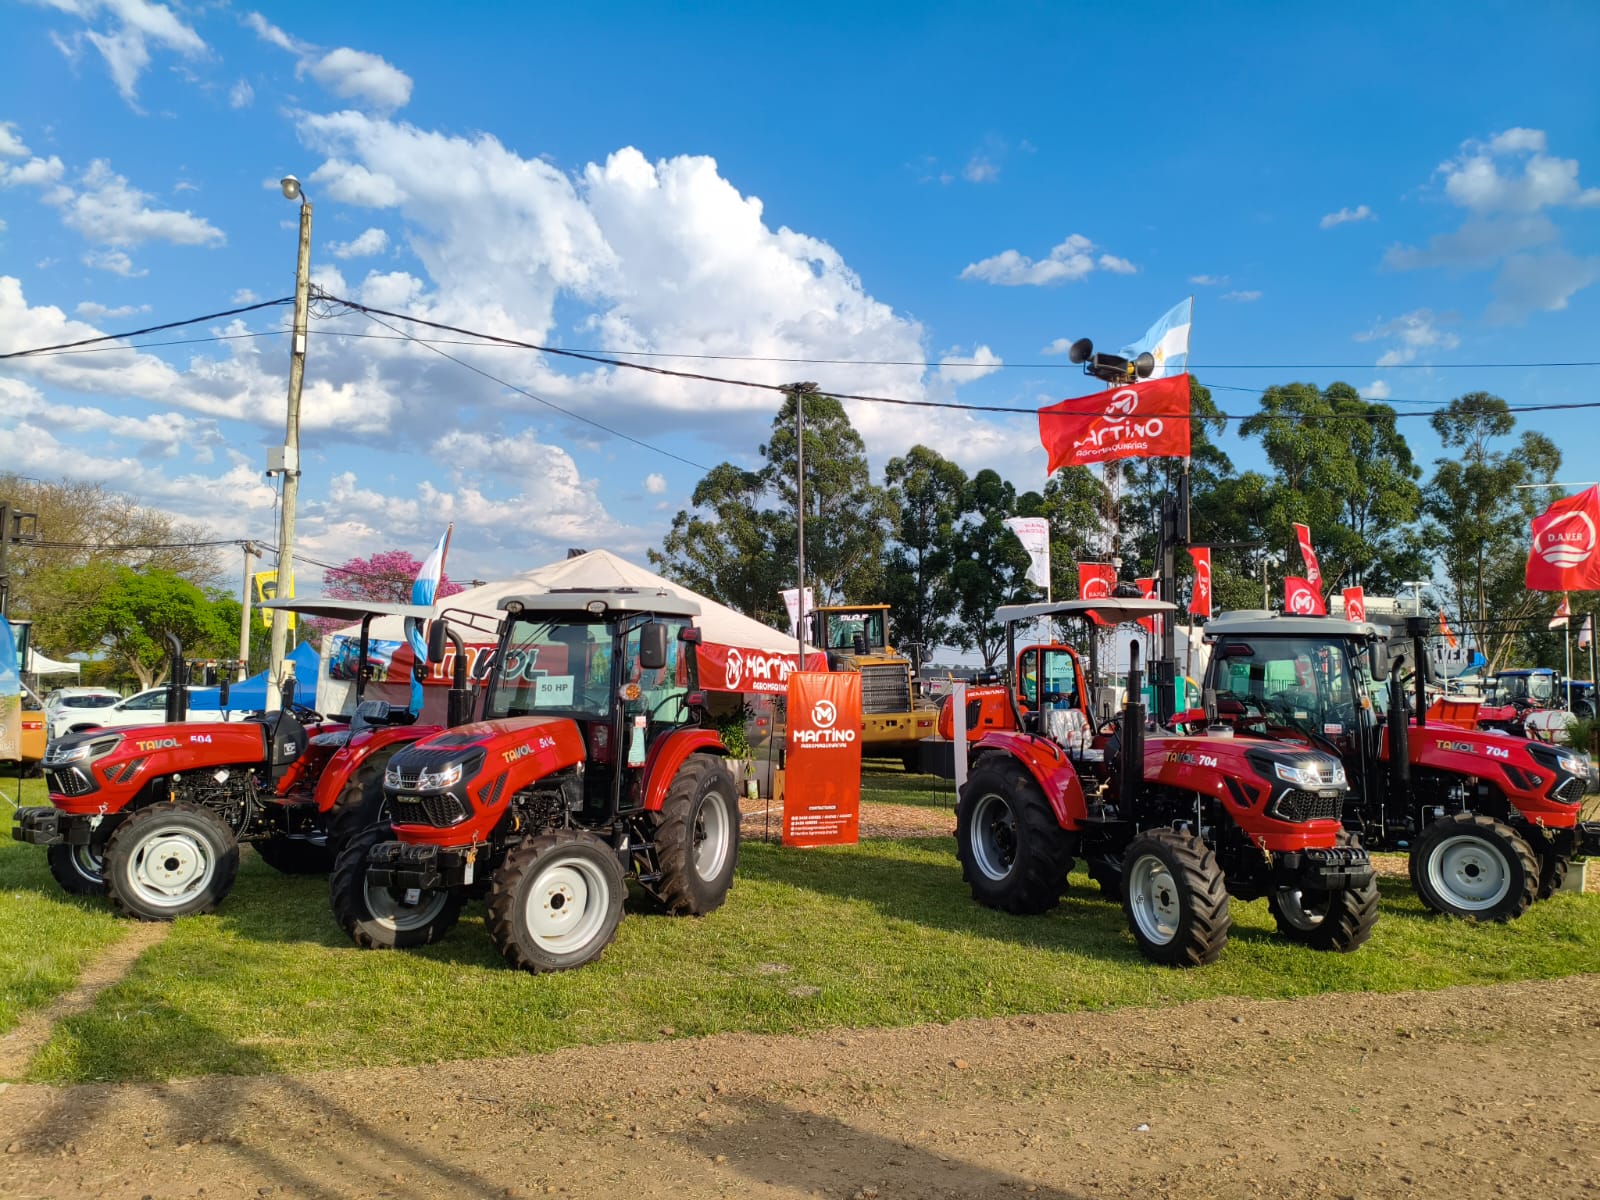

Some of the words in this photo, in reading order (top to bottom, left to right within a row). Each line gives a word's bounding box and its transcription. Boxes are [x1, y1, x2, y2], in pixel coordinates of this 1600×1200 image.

[541, 684, 552, 692] 50
[555, 683, 569, 692] HP
[136, 738, 182, 751] TAVOL
[190, 735, 212, 744] 504
[1436, 739, 1479, 754] TAVOL
[1486, 745, 1509, 758] 704
[502, 744, 535, 763] TAVOL
[1166, 752, 1198, 766] TAVOL
[1198, 755, 1218, 768] 704
